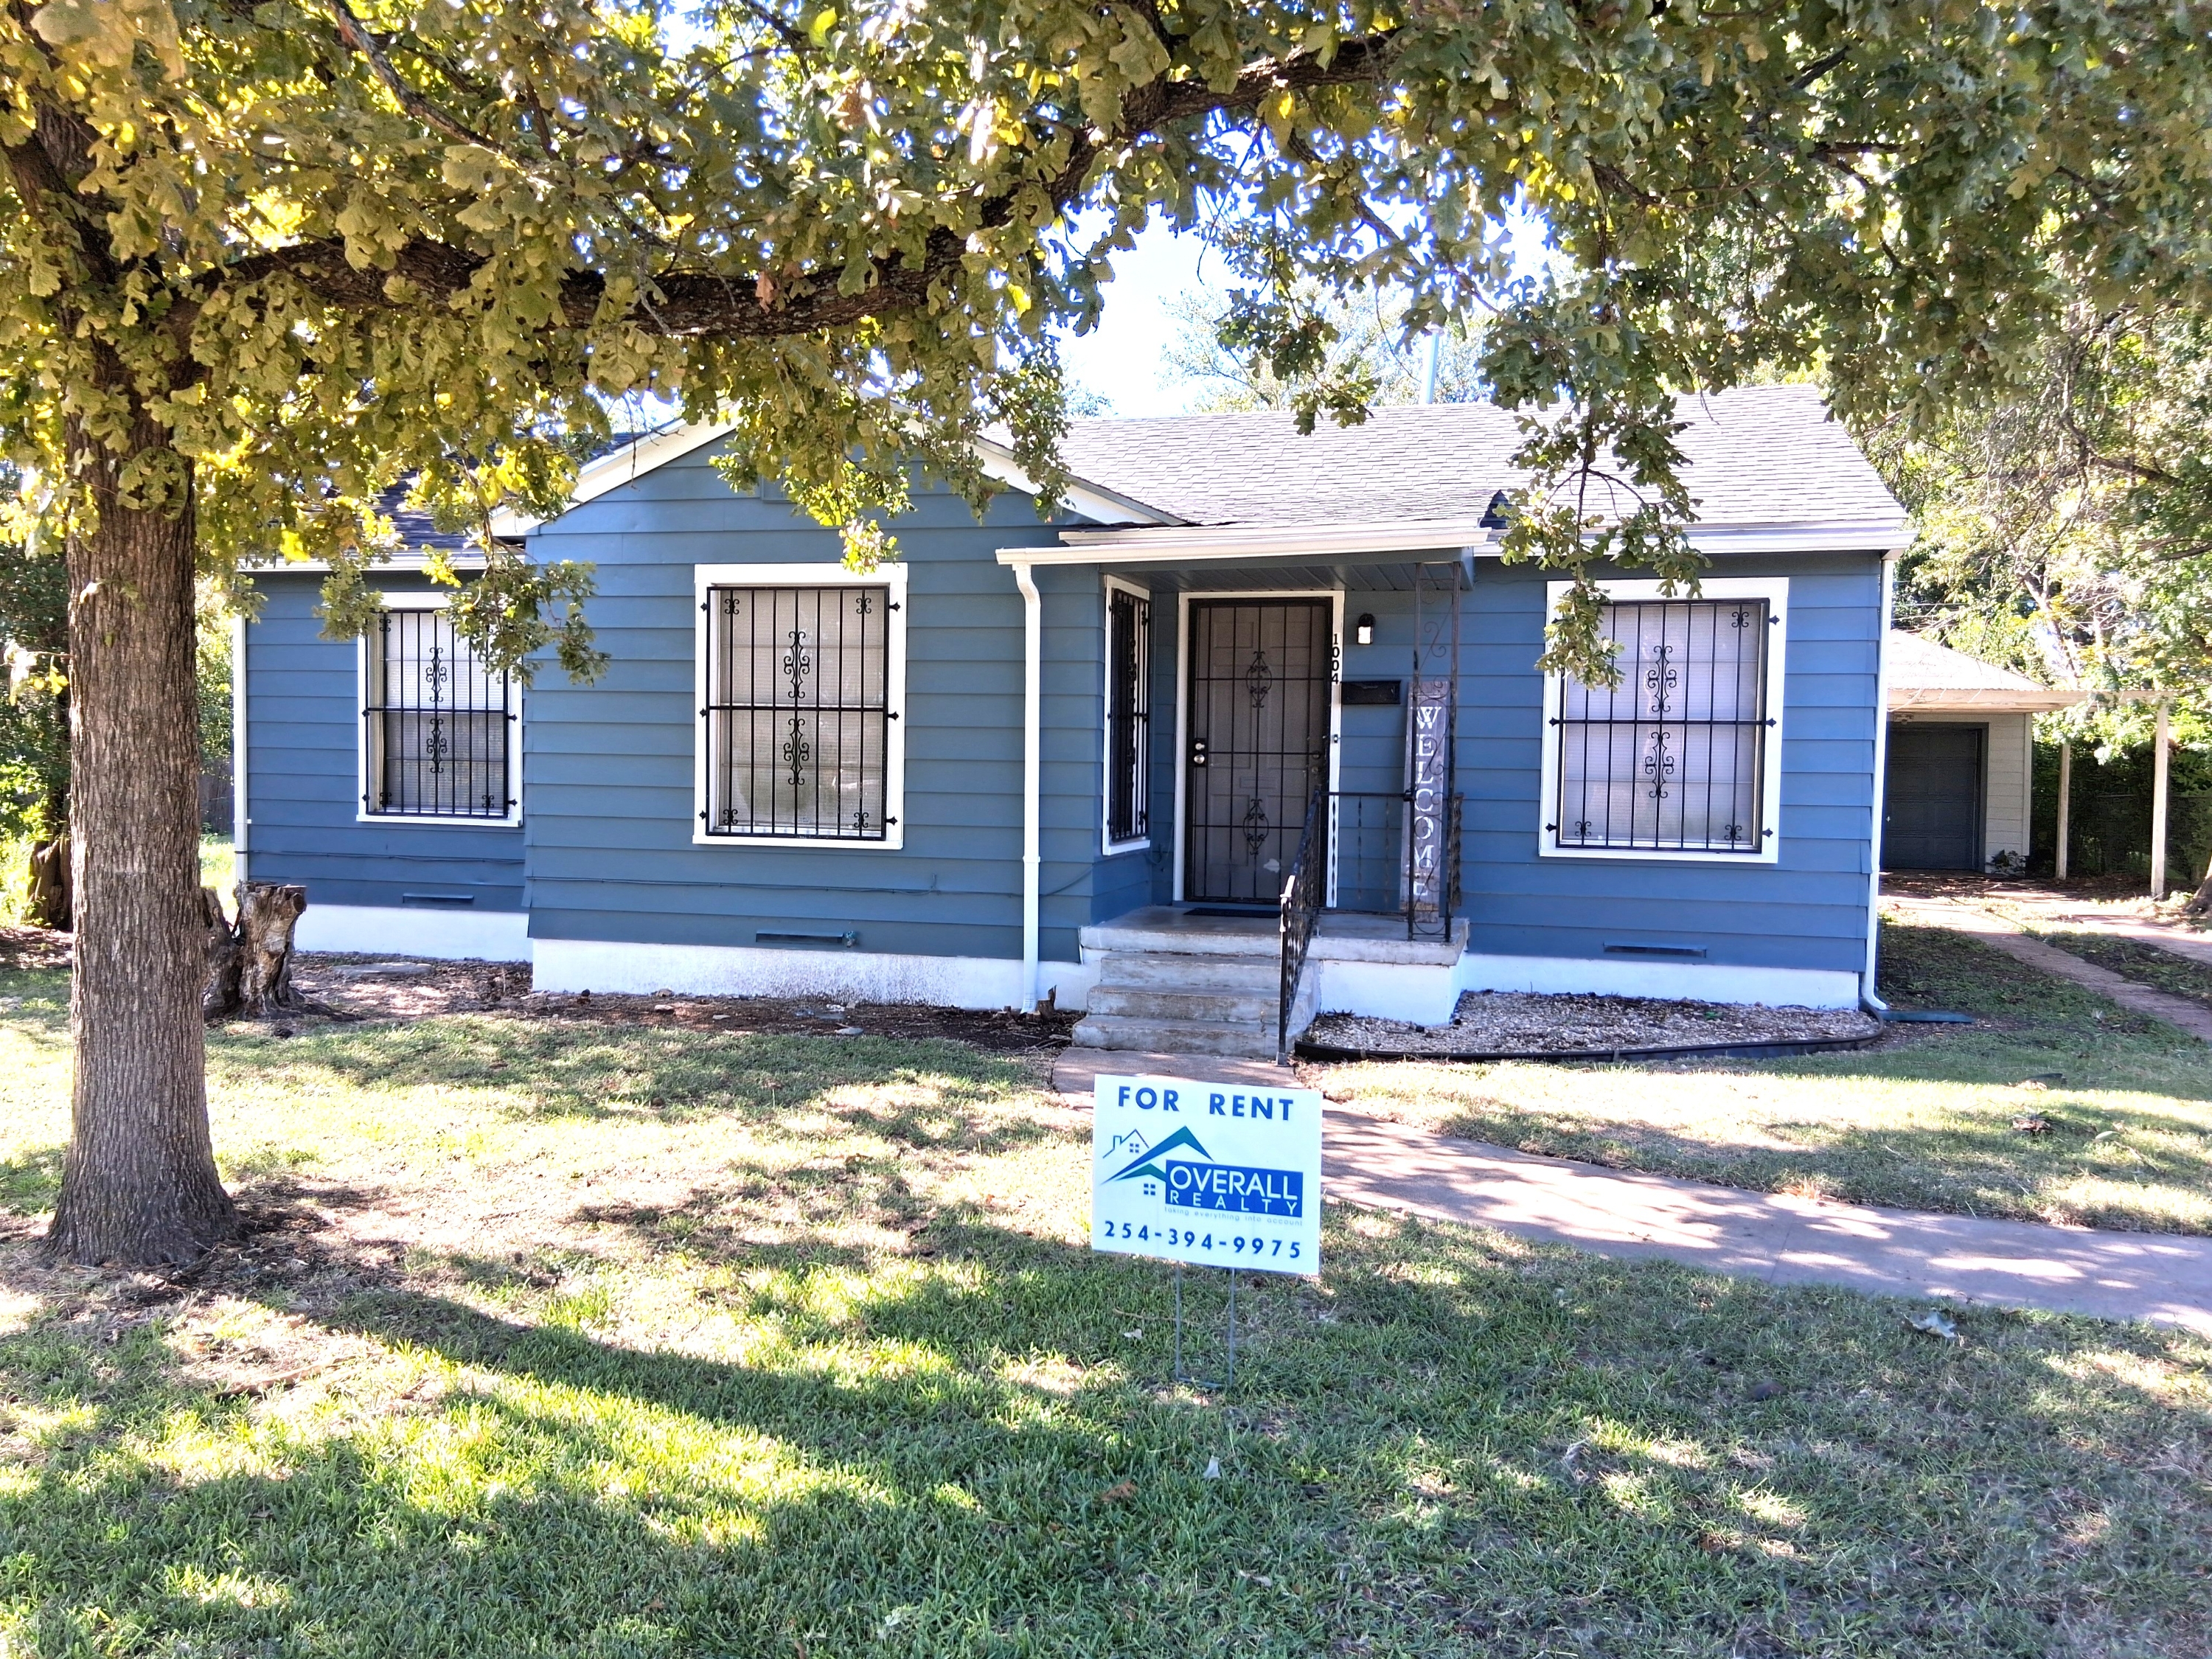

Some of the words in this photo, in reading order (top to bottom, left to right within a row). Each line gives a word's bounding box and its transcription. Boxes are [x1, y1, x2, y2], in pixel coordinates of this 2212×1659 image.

[1332, 633, 1340, 685] 1004
[1118, 1085, 1180, 1112] FOR
[1209, 1093, 1294, 1121] RENT
[1169, 1165, 1298, 1200] OVERALL
[1164, 1206, 1189, 1217] taking
[1194, 1210, 1240, 1222] everything
[1245, 1214, 1262, 1222] into
[1267, 1217, 1303, 1226] account
[1169, 1189, 1298, 1216] REALTY
[1105, 1220, 1301, 1259] 254-394-9975
